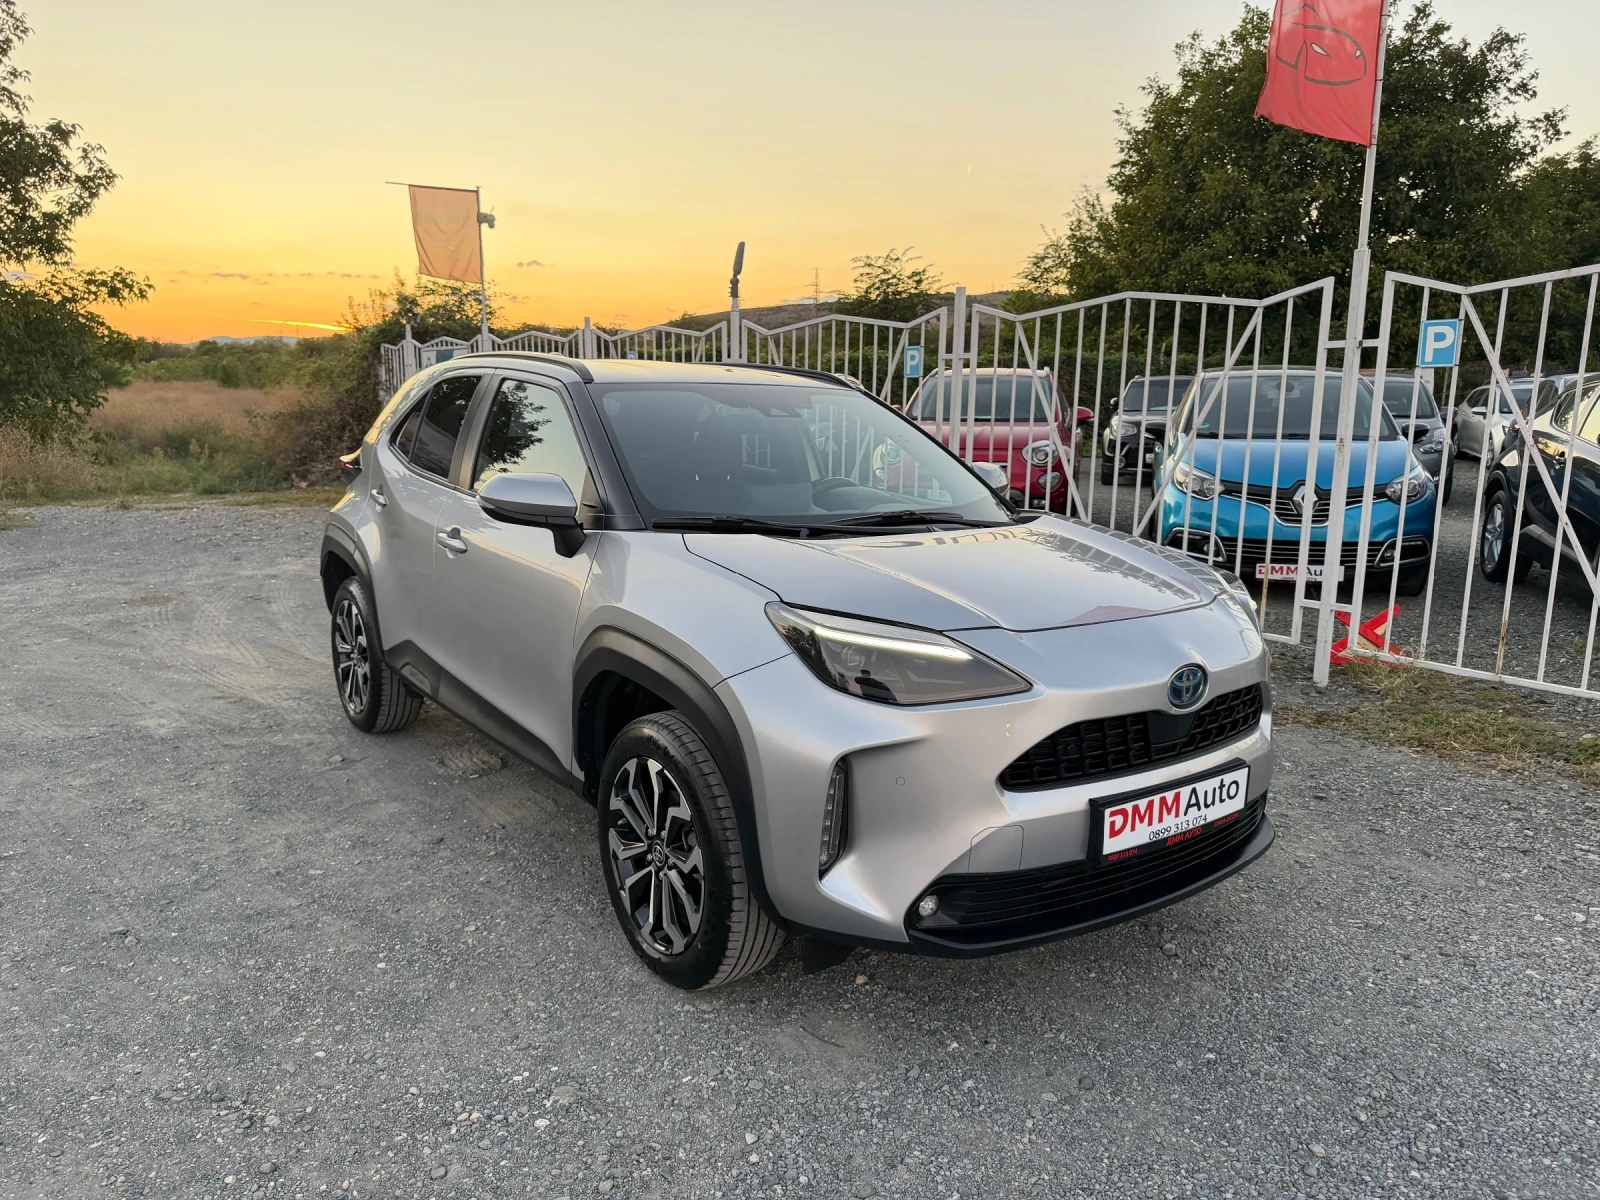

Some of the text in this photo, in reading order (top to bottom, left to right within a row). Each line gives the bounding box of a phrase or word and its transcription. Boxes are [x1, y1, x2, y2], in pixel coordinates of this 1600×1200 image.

[1424, 325, 1455, 362] P
[906, 350, 919, 375] P
[1148, 826, 1172, 841] 0899
[1173, 819, 1190, 834] 313
[1192, 813, 1208, 827] 074
[1166, 827, 1202, 847] ДММ АУТО
